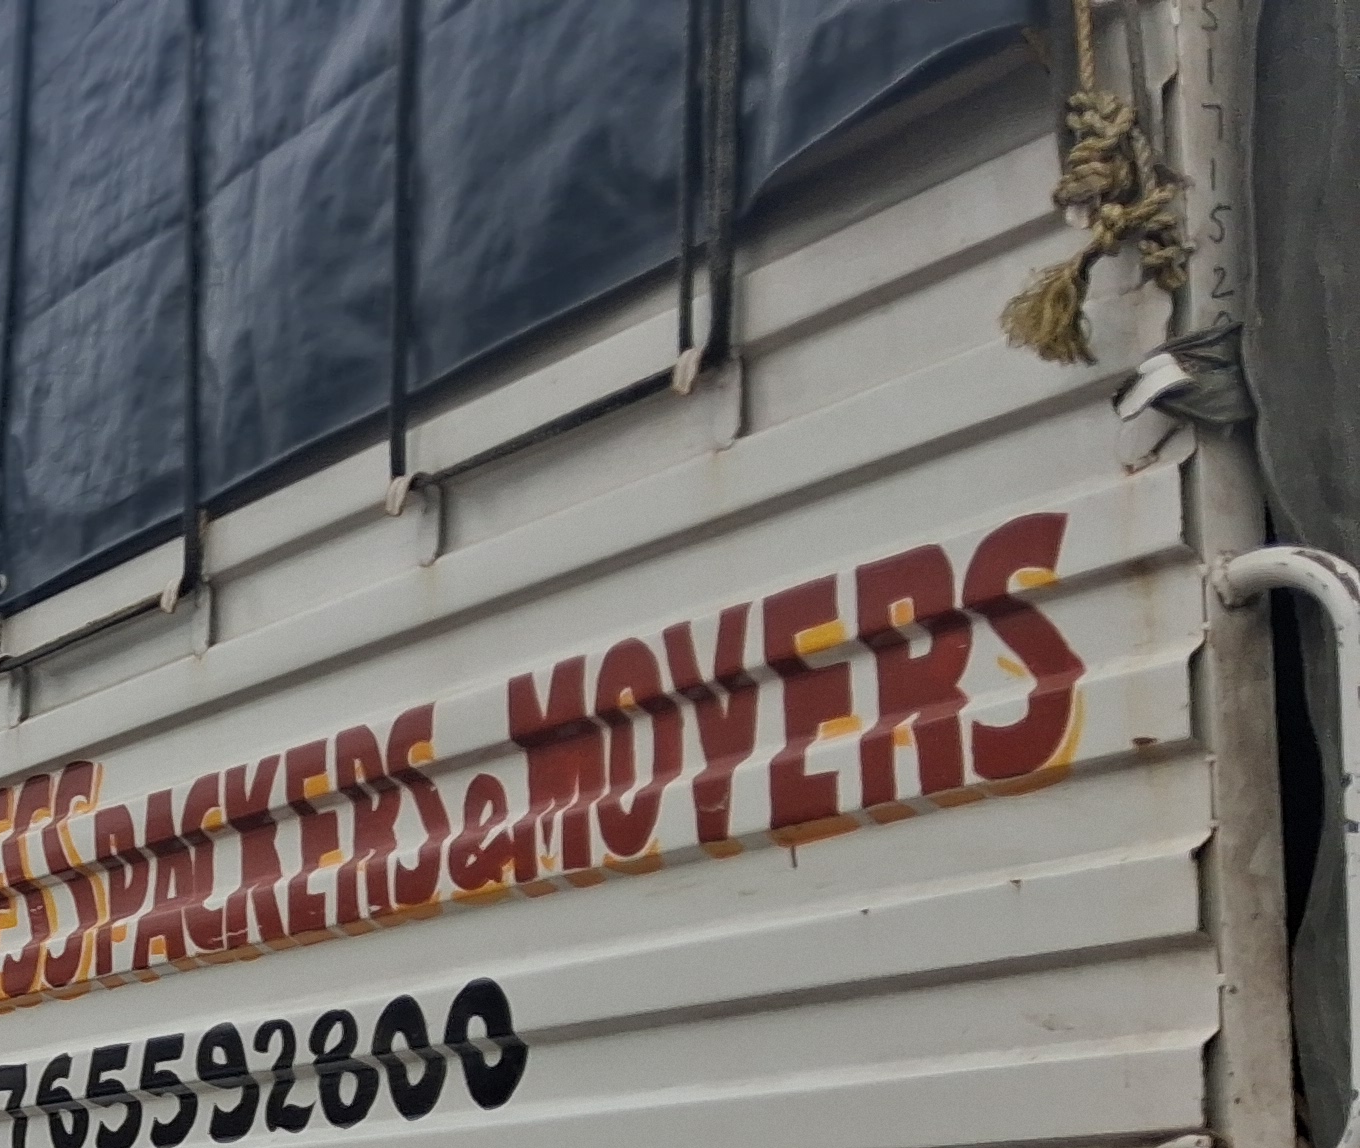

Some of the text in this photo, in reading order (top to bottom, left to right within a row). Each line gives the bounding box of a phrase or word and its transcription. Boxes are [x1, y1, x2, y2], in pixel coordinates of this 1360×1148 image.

[92, 703, 445, 980] PACKERS
[448, 773, 518, 893] &
[508, 512, 1086, 882] MOVERS
